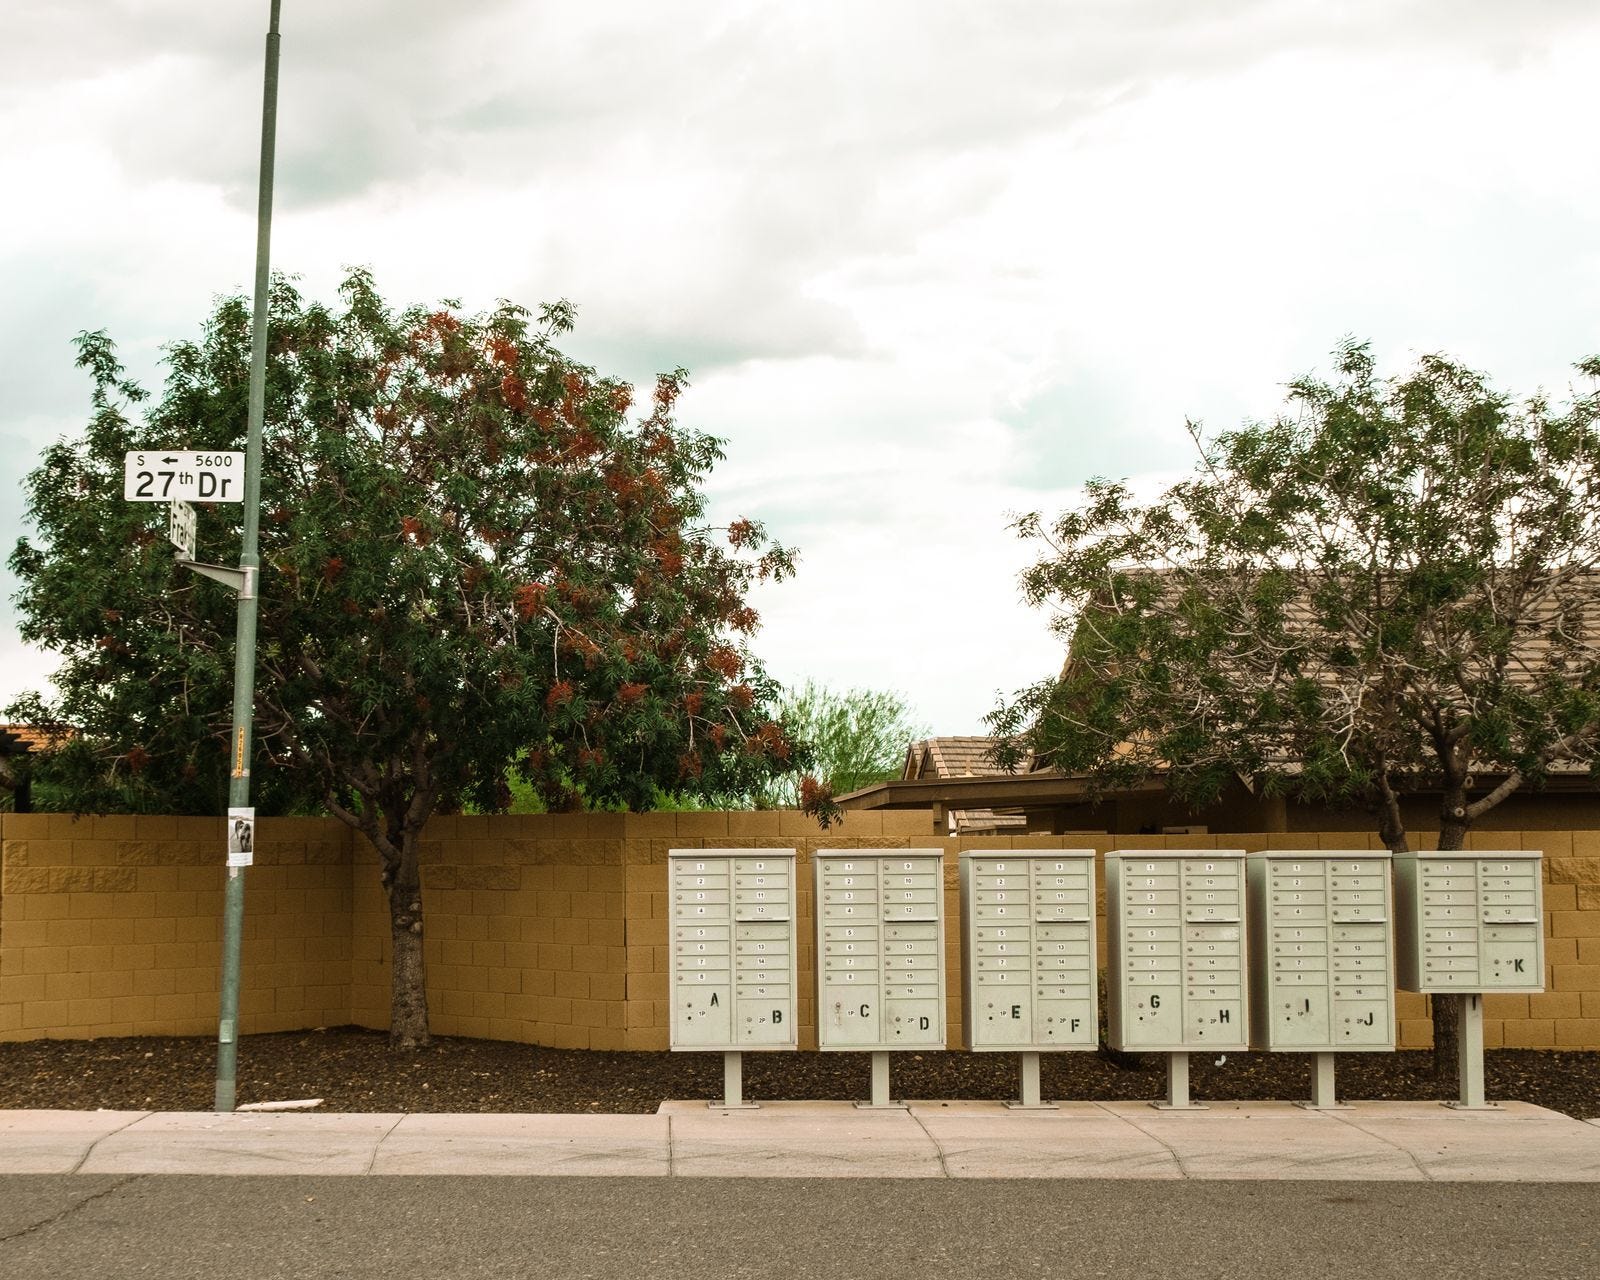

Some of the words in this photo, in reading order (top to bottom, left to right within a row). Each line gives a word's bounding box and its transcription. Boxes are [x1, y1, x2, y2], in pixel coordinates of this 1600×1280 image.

[137, 455, 145, 466] S
[196, 455, 232, 467] 5600
[136, 471, 193, 497] 27th
[199, 472, 231, 497] Dr
[1514, 959, 1524, 972] K
[710, 992, 719, 1007] A
[1150, 995, 1160, 1008] G
[1305, 998, 1309, 1013] I
[772, 1010, 782, 1024] B
[860, 1004, 870, 1017] C
[1011, 1005, 1021, 1019] E
[1219, 1010, 1230, 1024] H
[919, 1016, 929, 1030] D
[1071, 1019, 1080, 1033] F
[1364, 1012, 1373, 1026] J
